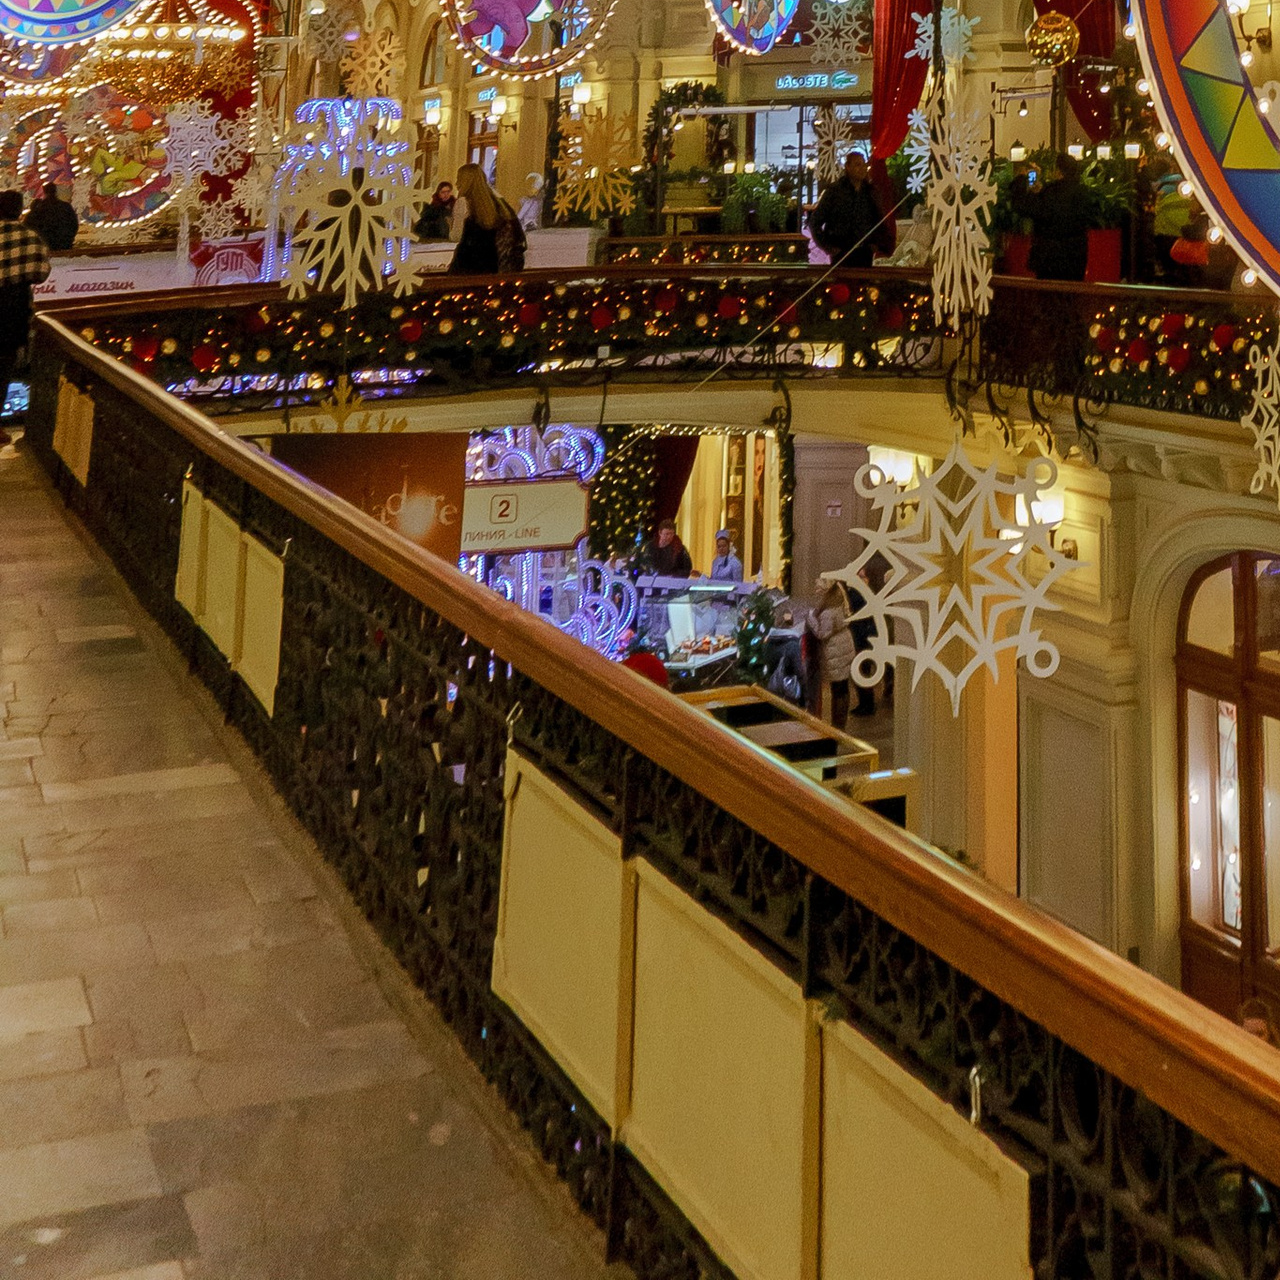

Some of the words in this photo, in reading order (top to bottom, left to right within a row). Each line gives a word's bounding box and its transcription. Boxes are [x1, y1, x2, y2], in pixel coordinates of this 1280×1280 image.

[776, 74, 828, 89] LACOSTE
[65, 280, 135, 293] магазин
[498, 499, 511, 518] 2
[464, 529, 506, 542] ЛИНИЯ
[515, 527, 541, 539] LINE
